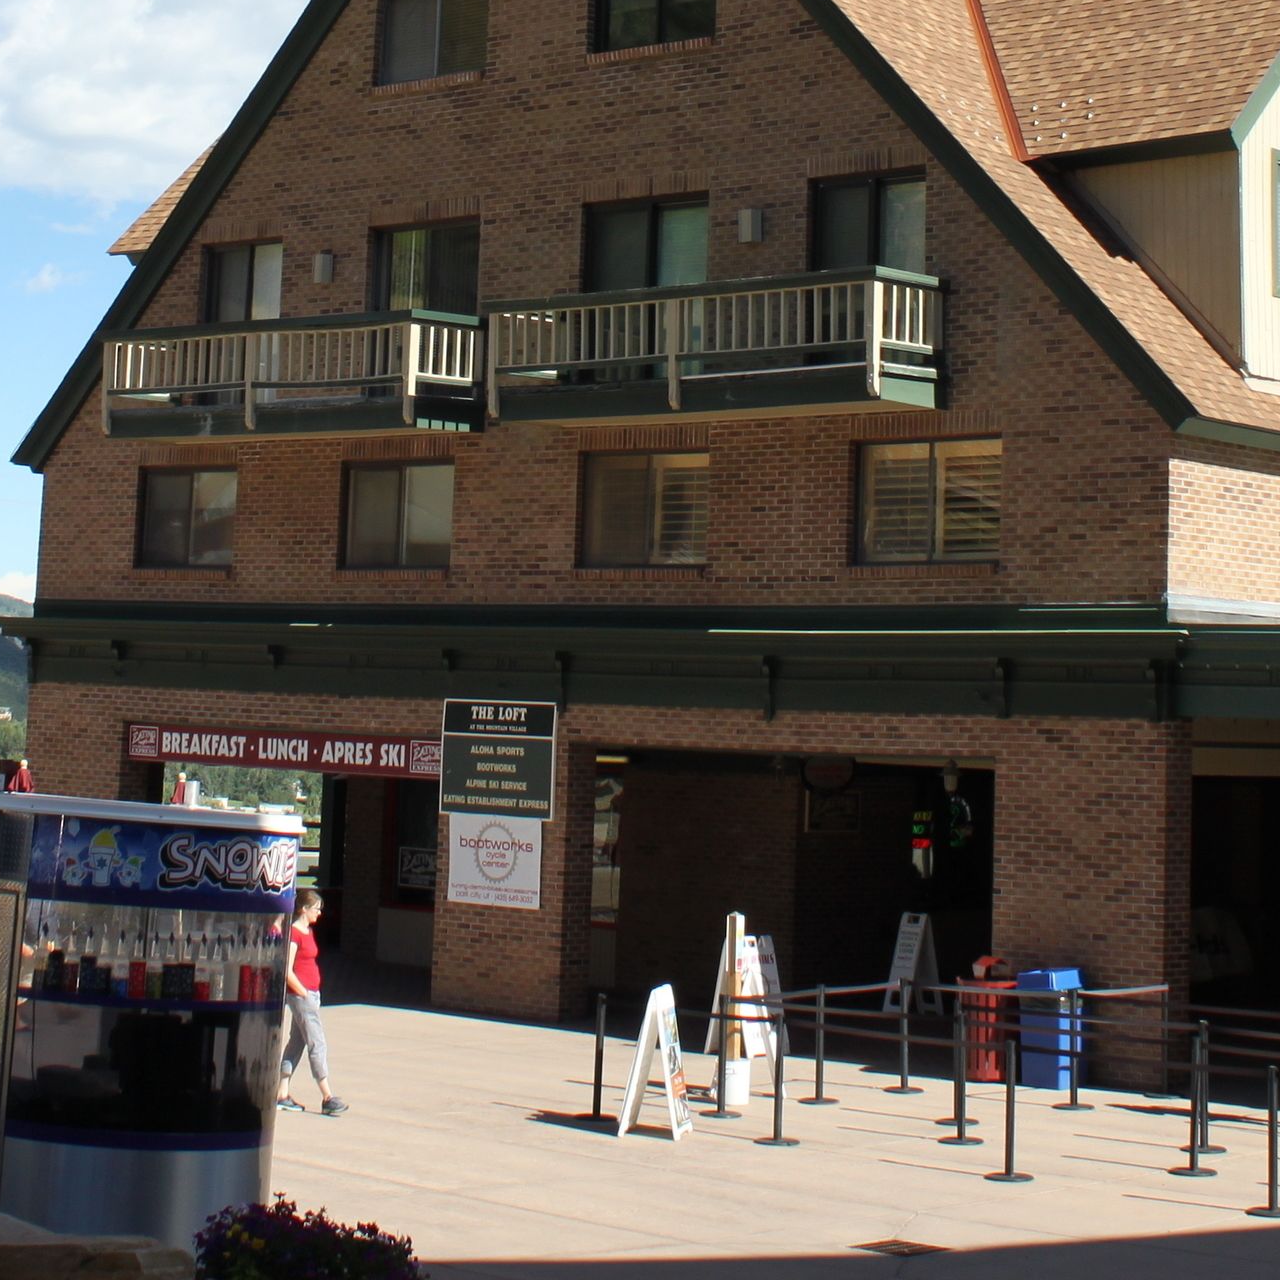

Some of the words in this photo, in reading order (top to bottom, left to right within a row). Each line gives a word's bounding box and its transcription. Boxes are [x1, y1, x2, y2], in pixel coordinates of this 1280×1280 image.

[471, 705, 495, 720] THE
[498, 706, 528, 722] LOFT
[162, 731, 246, 758] BREAKFAST
[258, 737, 309, 762] LUNCH
[321, 740, 373, 766] APRES
[379, 743, 406, 768] SKI
[470, 745, 495, 755] ALOHA
[496, 746, 525, 757] SPORTS
[476, 762, 517, 773] BOOTWORKS
[465, 779, 487, 789] ALPINE
[488, 780, 500, 790] SKI
[501, 781, 528, 792] SERVICE
[443, 794, 466, 804] EATING
[466, 795, 517, 808] ESTABLISHMENT
[519, 799, 549, 810] EXPRESS
[459, 834, 534, 853] bootworks
[485, 851, 507, 861] cycle
[481, 860, 510, 869] center
